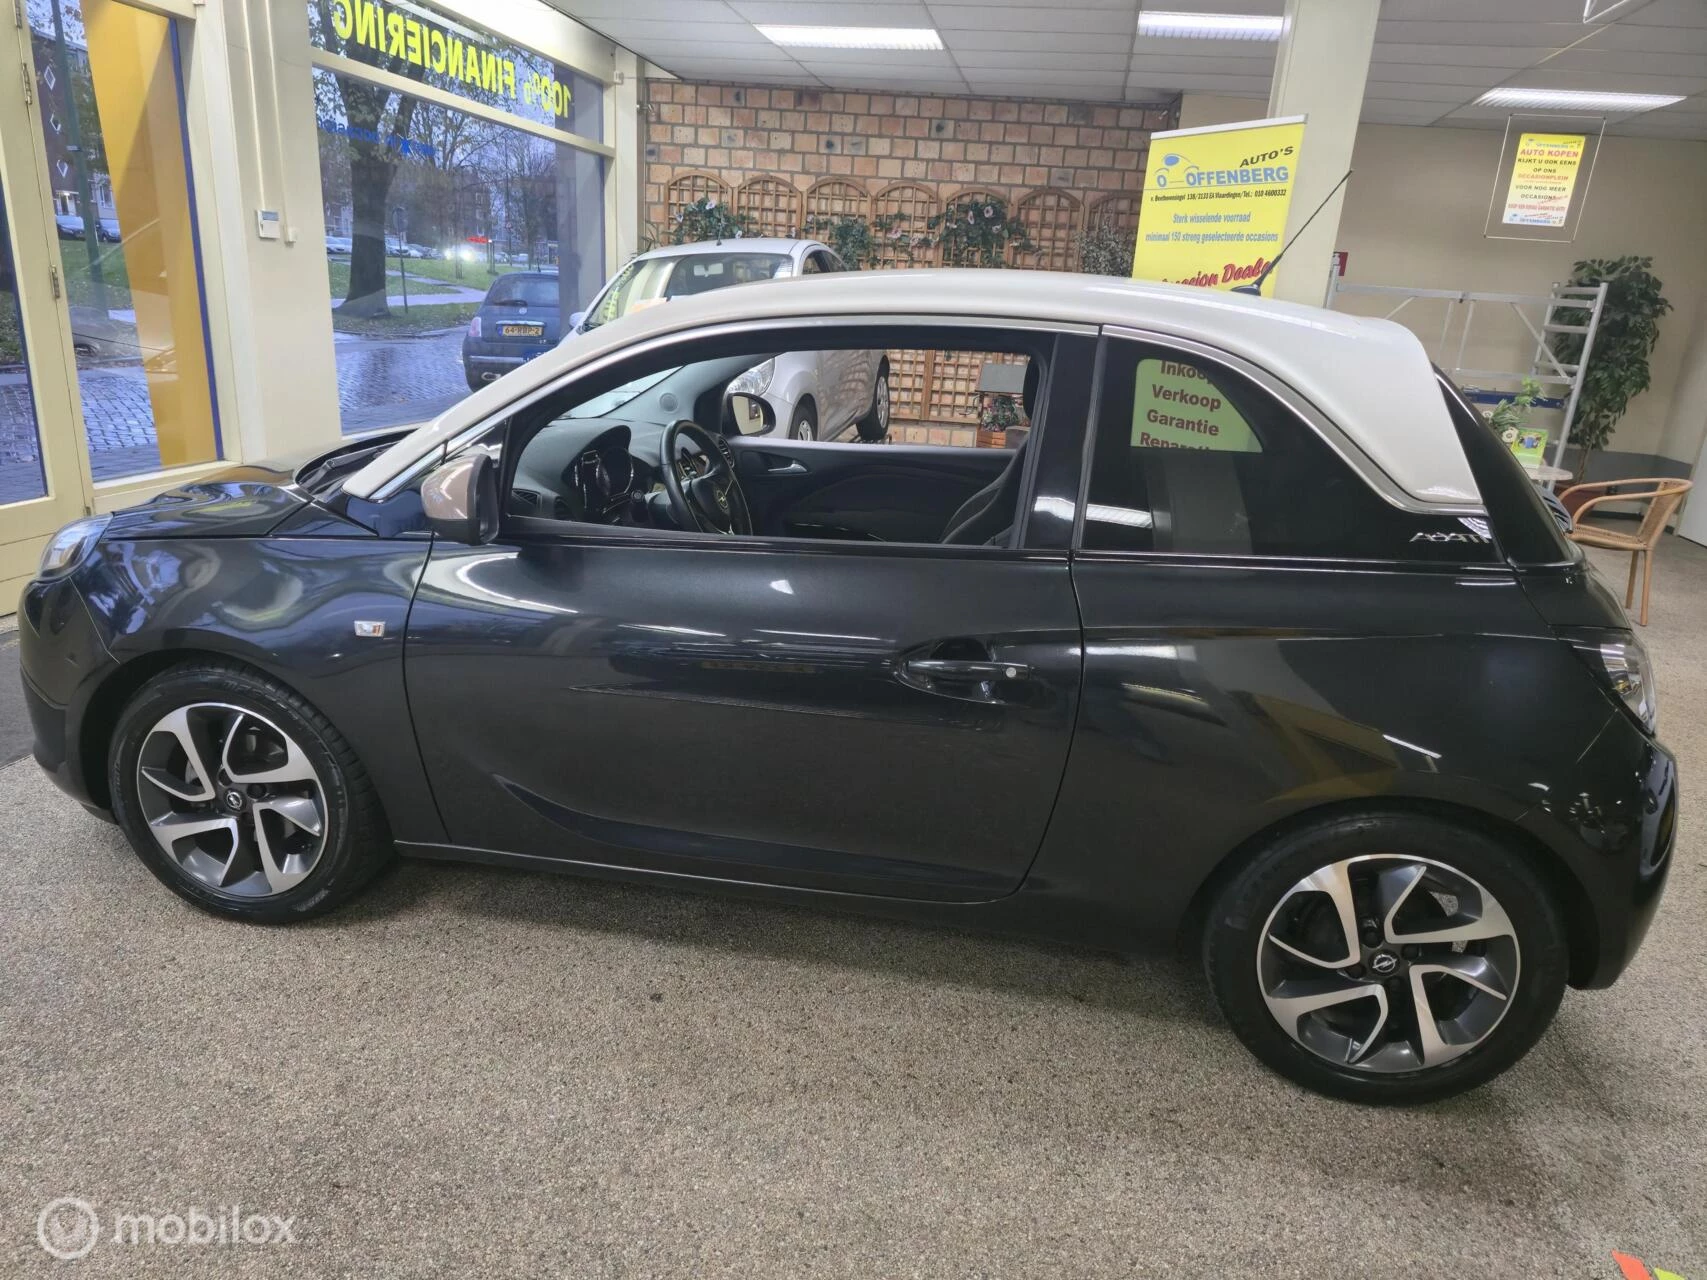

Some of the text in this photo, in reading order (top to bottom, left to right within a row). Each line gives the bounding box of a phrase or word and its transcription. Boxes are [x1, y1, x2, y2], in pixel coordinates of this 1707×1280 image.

[1239, 146, 1294, 168] AUTO'S
[1547, 150, 1579, 158] KOPEN
[1185, 166, 1289, 187] OFFENBERG
[1190, 212, 1221, 223] wisselende
[1223, 212, 1251, 222] voorraad
[1145, 231, 1278, 244] minimaal 150 streng geselecteerde occasions
[1152, 384, 1222, 412] Verkoop
[1147, 409, 1220, 436] Garantie
